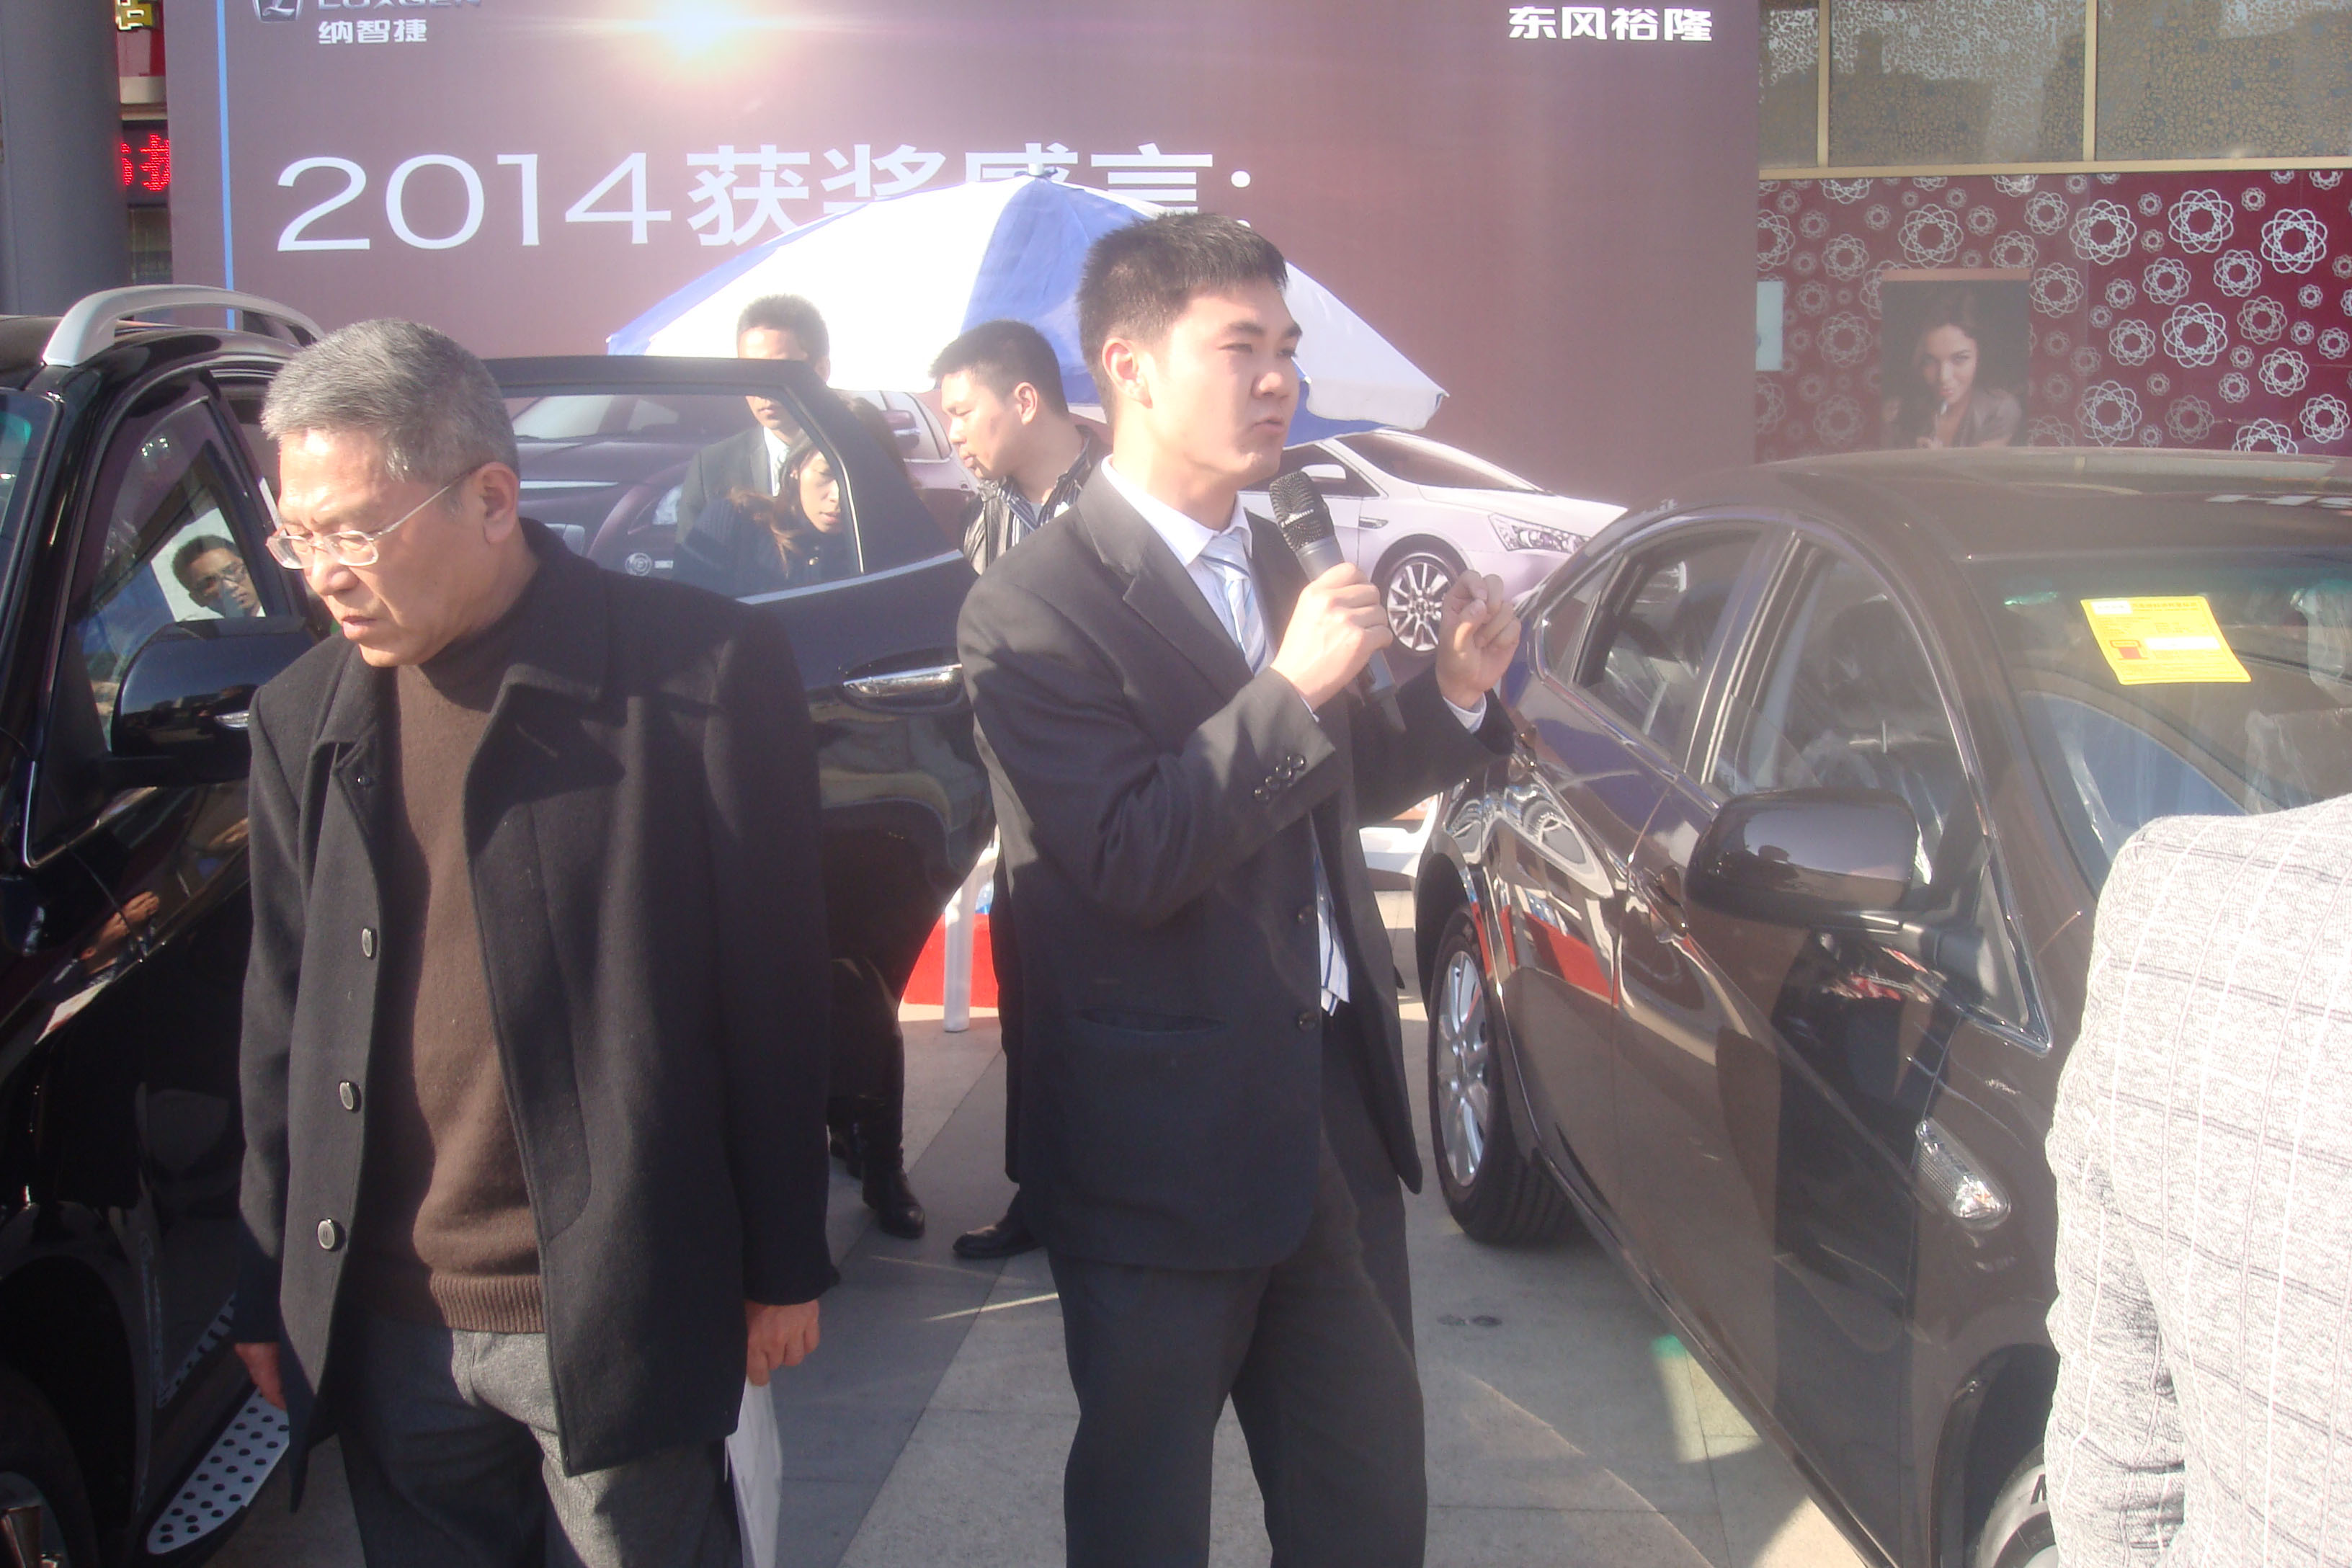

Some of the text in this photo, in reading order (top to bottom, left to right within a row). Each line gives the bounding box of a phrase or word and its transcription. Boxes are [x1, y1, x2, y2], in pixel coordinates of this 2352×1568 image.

[318, 19, 427, 44] 纳智捷
[1509, 6, 1713, 41] 东风裕隆
